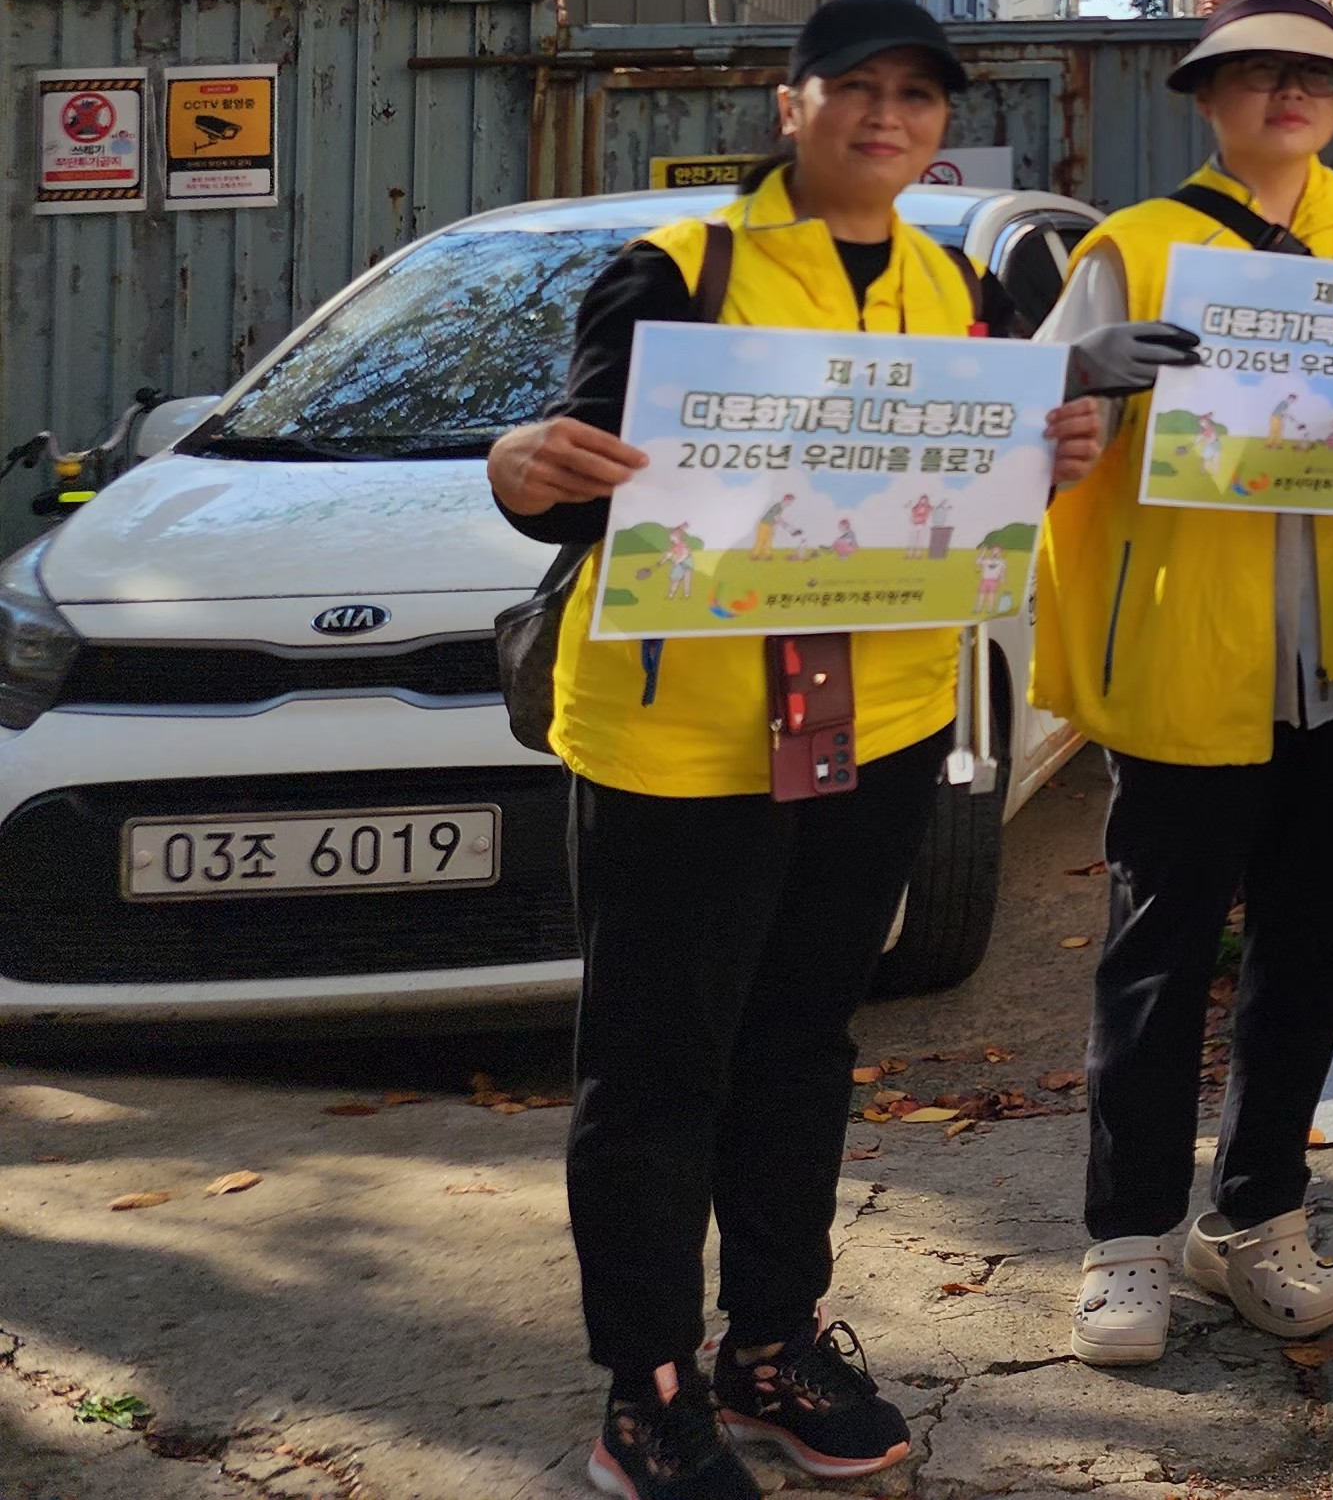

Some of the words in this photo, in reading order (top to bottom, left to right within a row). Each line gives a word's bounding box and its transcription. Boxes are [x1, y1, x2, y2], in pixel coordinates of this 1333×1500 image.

[184, 100, 219, 110] CCTV
[71, 145, 105, 156] 쓰레기
[826, 358, 851, 386] 제
[866, 362, 876, 386] 1
[886, 362, 913, 388] 회
[1200, 347, 1290, 374] 2026년
[681, 392, 853, 433] 다문화가족
[859, 398, 1015, 438] 나눔봉사단
[678, 442, 793, 470] 2026년
[801, 444, 911, 472] 우리마을
[919, 447, 995, 474] 플로깅
[323, 606, 374, 629] KIA
[164, 831, 277, 883] 03조
[309, 821, 462, 878] 6019
